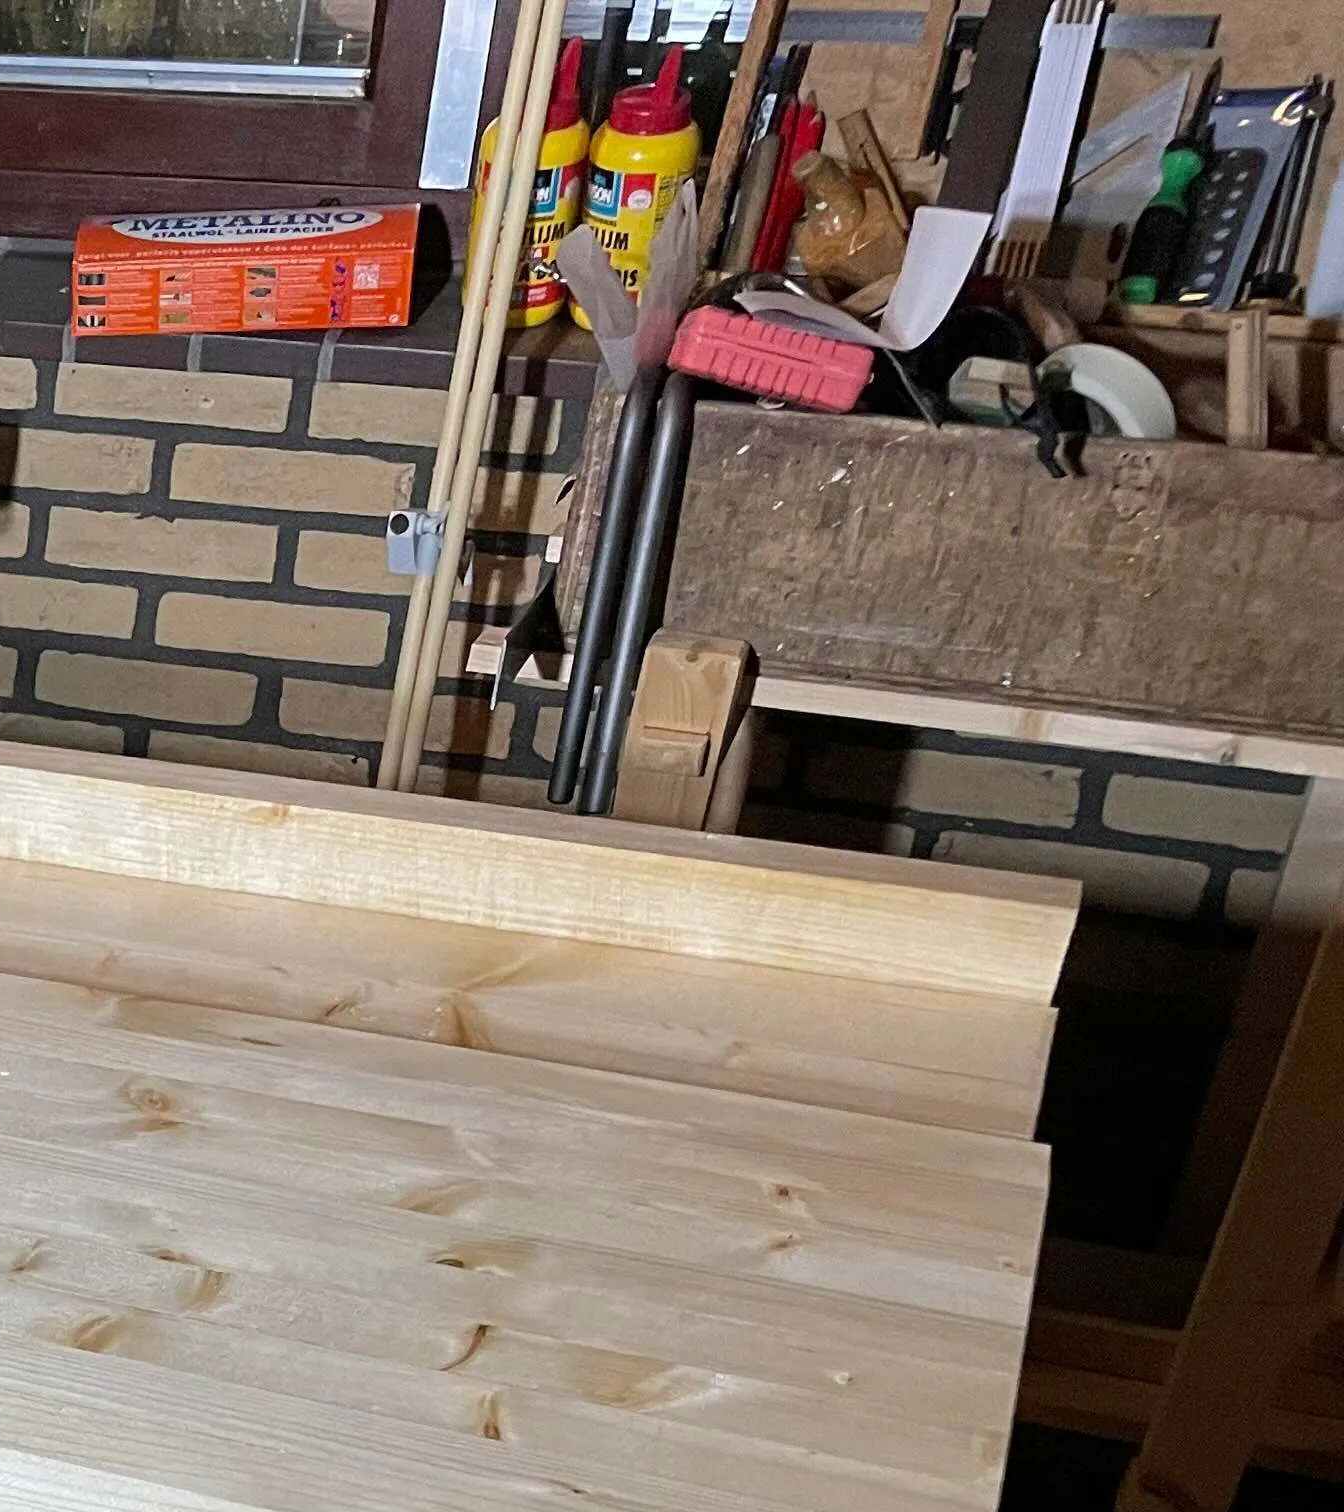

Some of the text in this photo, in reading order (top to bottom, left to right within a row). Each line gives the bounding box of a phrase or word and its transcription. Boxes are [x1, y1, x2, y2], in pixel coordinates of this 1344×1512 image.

[128, 212, 365, 231] METALINO
[152, 230, 223, 238] STAALWOL
[236, 227, 279, 236] LAINE
